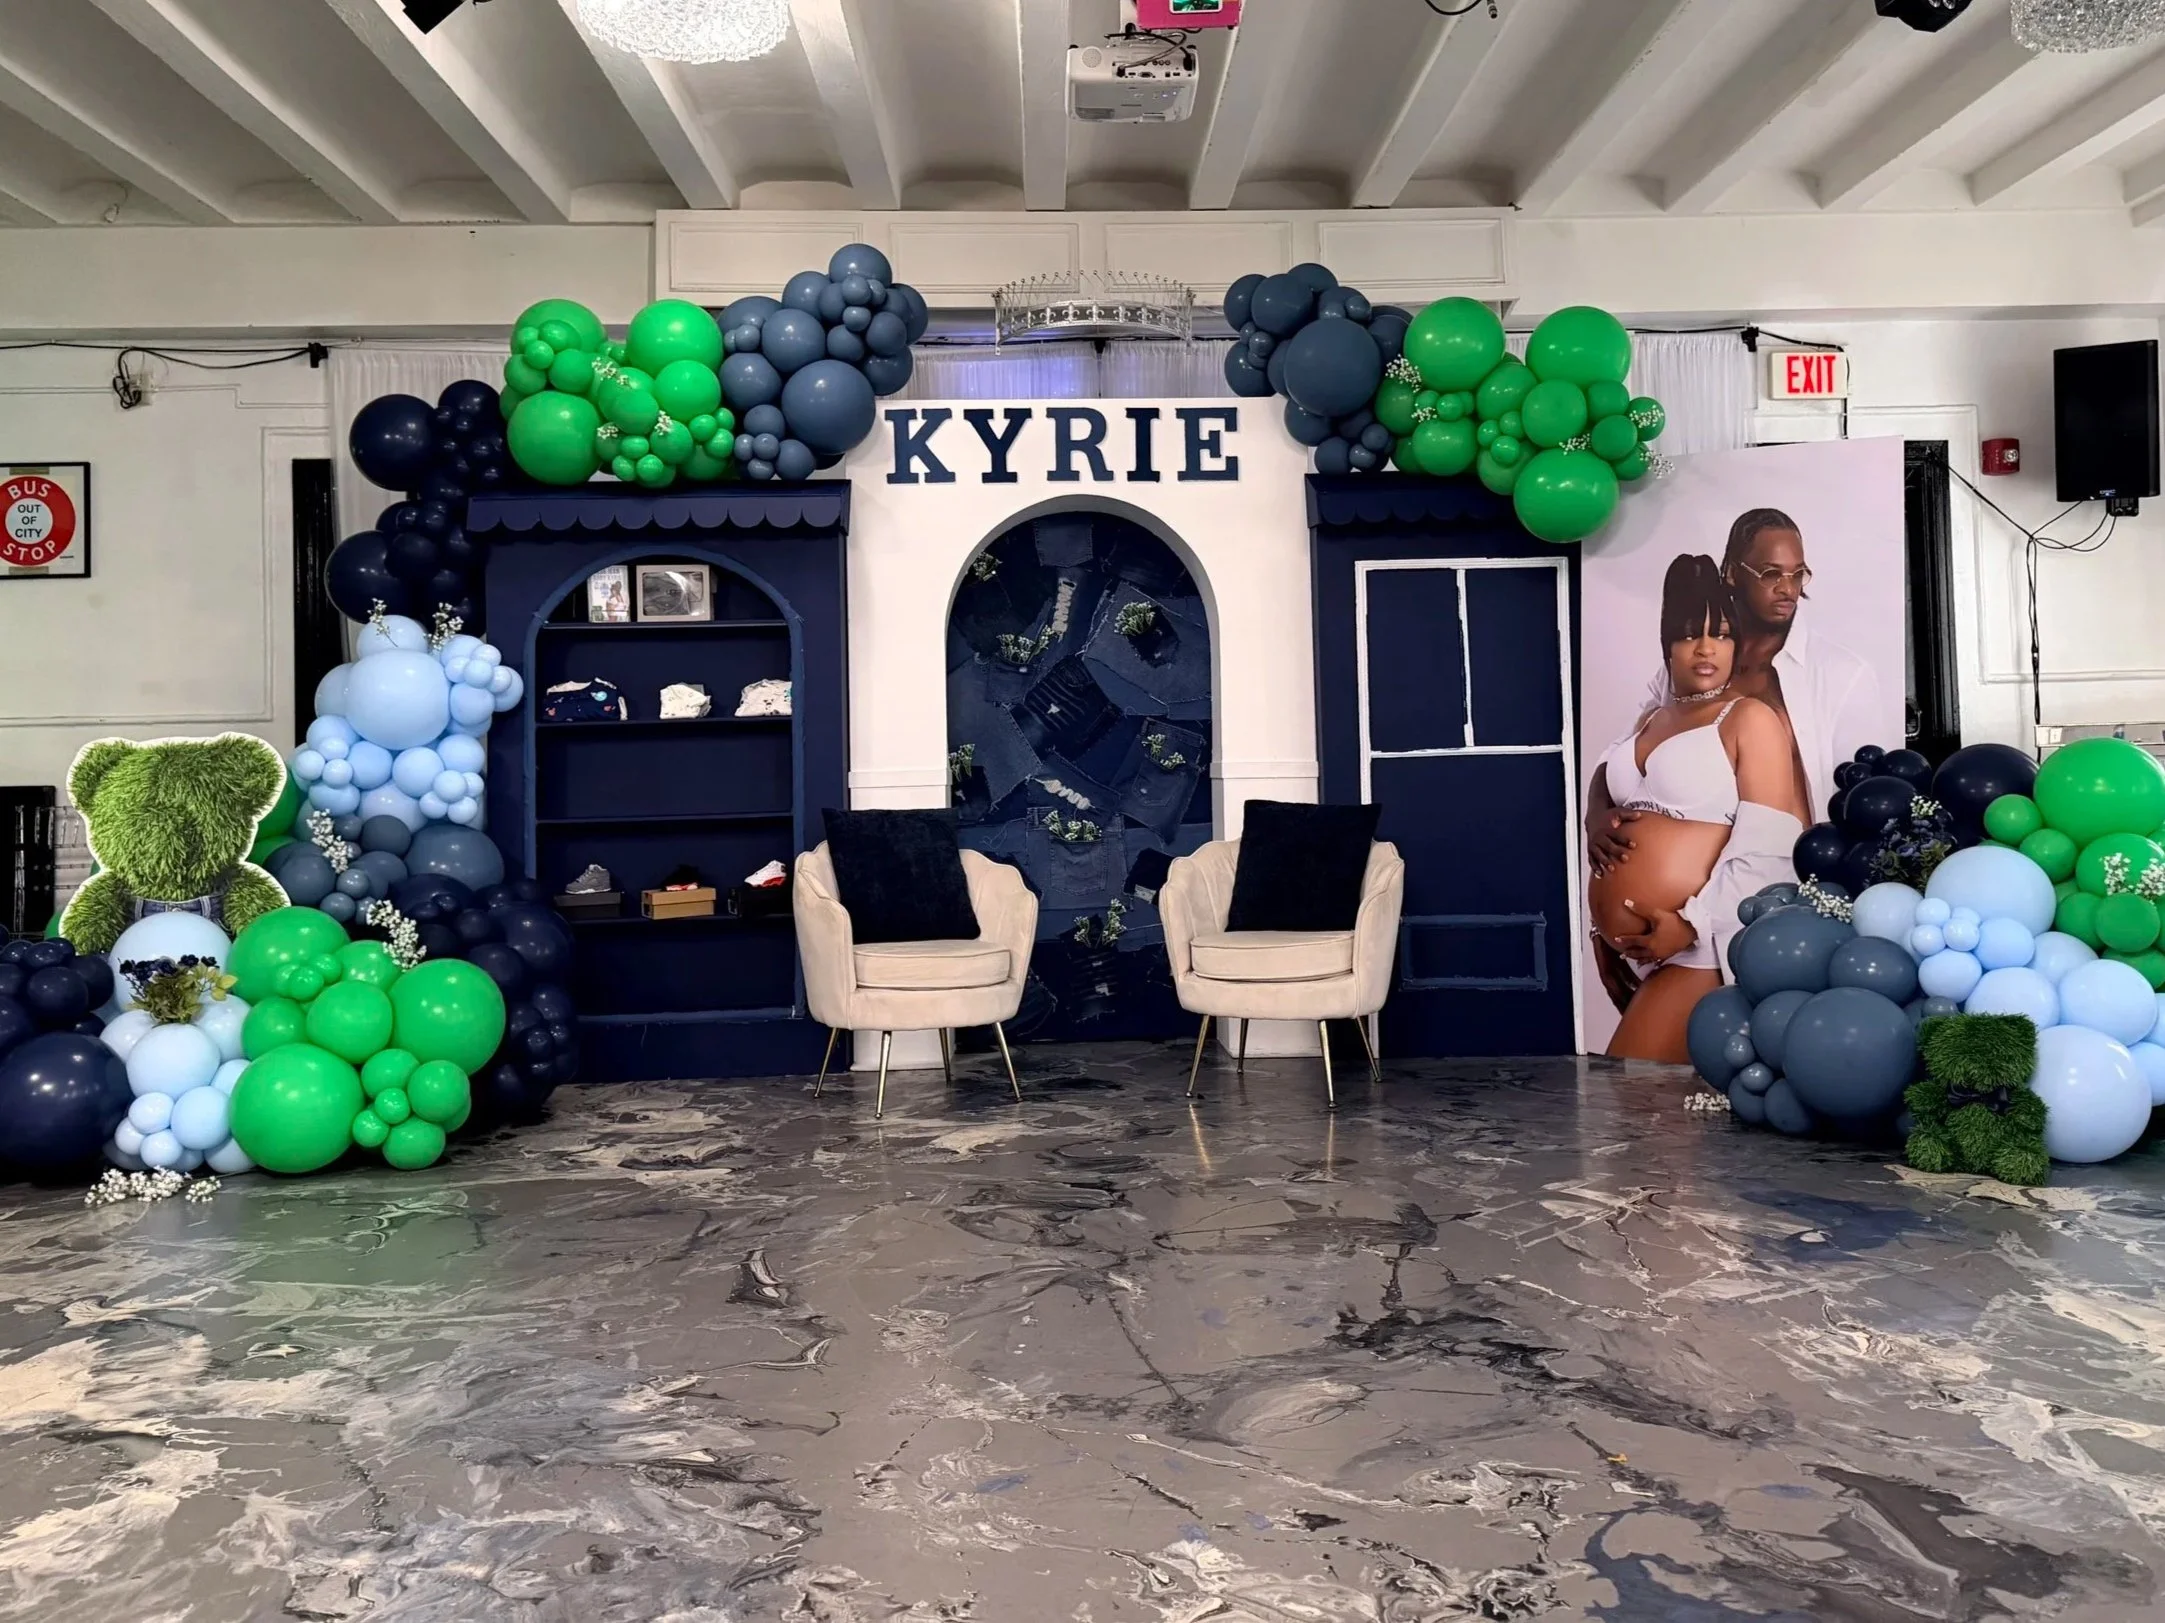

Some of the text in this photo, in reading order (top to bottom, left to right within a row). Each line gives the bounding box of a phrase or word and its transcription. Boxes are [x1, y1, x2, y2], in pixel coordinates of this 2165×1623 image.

[1786, 355, 1836, 393] EXIT
[884, 407, 1239, 484] KYRIE
[7, 480, 51, 500] BUS
[17, 504, 41, 513] OUT
[21, 516, 37, 525] OF
[15, 529, 42, 538] CITY
[3, 540, 56, 561] STOP
